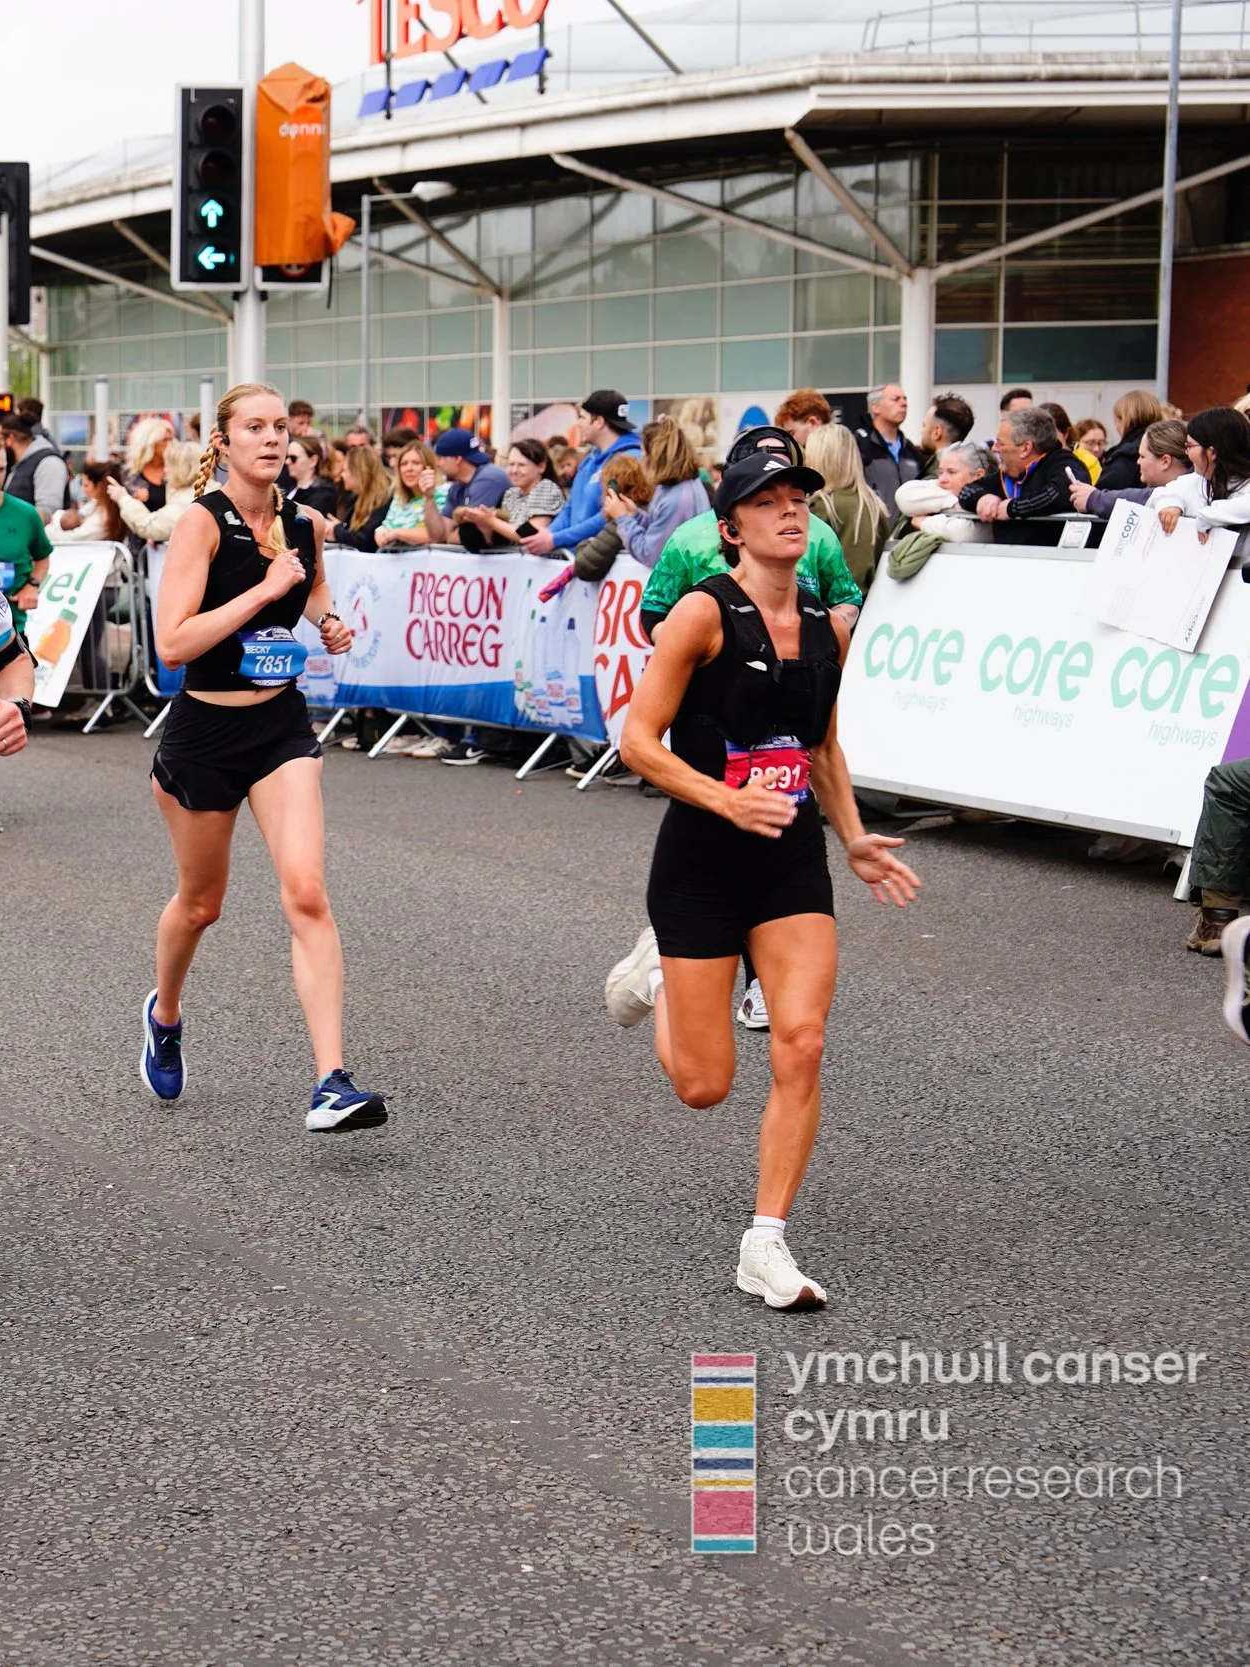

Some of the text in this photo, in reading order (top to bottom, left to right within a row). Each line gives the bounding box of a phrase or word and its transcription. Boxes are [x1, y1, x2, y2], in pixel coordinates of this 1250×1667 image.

[408, 571, 507, 620] BRECON
[245, 645, 271, 654] BECKY
[255, 655, 293, 674] 7851
[406, 618, 504, 668] CARREG
[864, 622, 1241, 719] core core core
[1012, 703, 1074, 731] highways
[1148, 719, 1219, 752] highways
